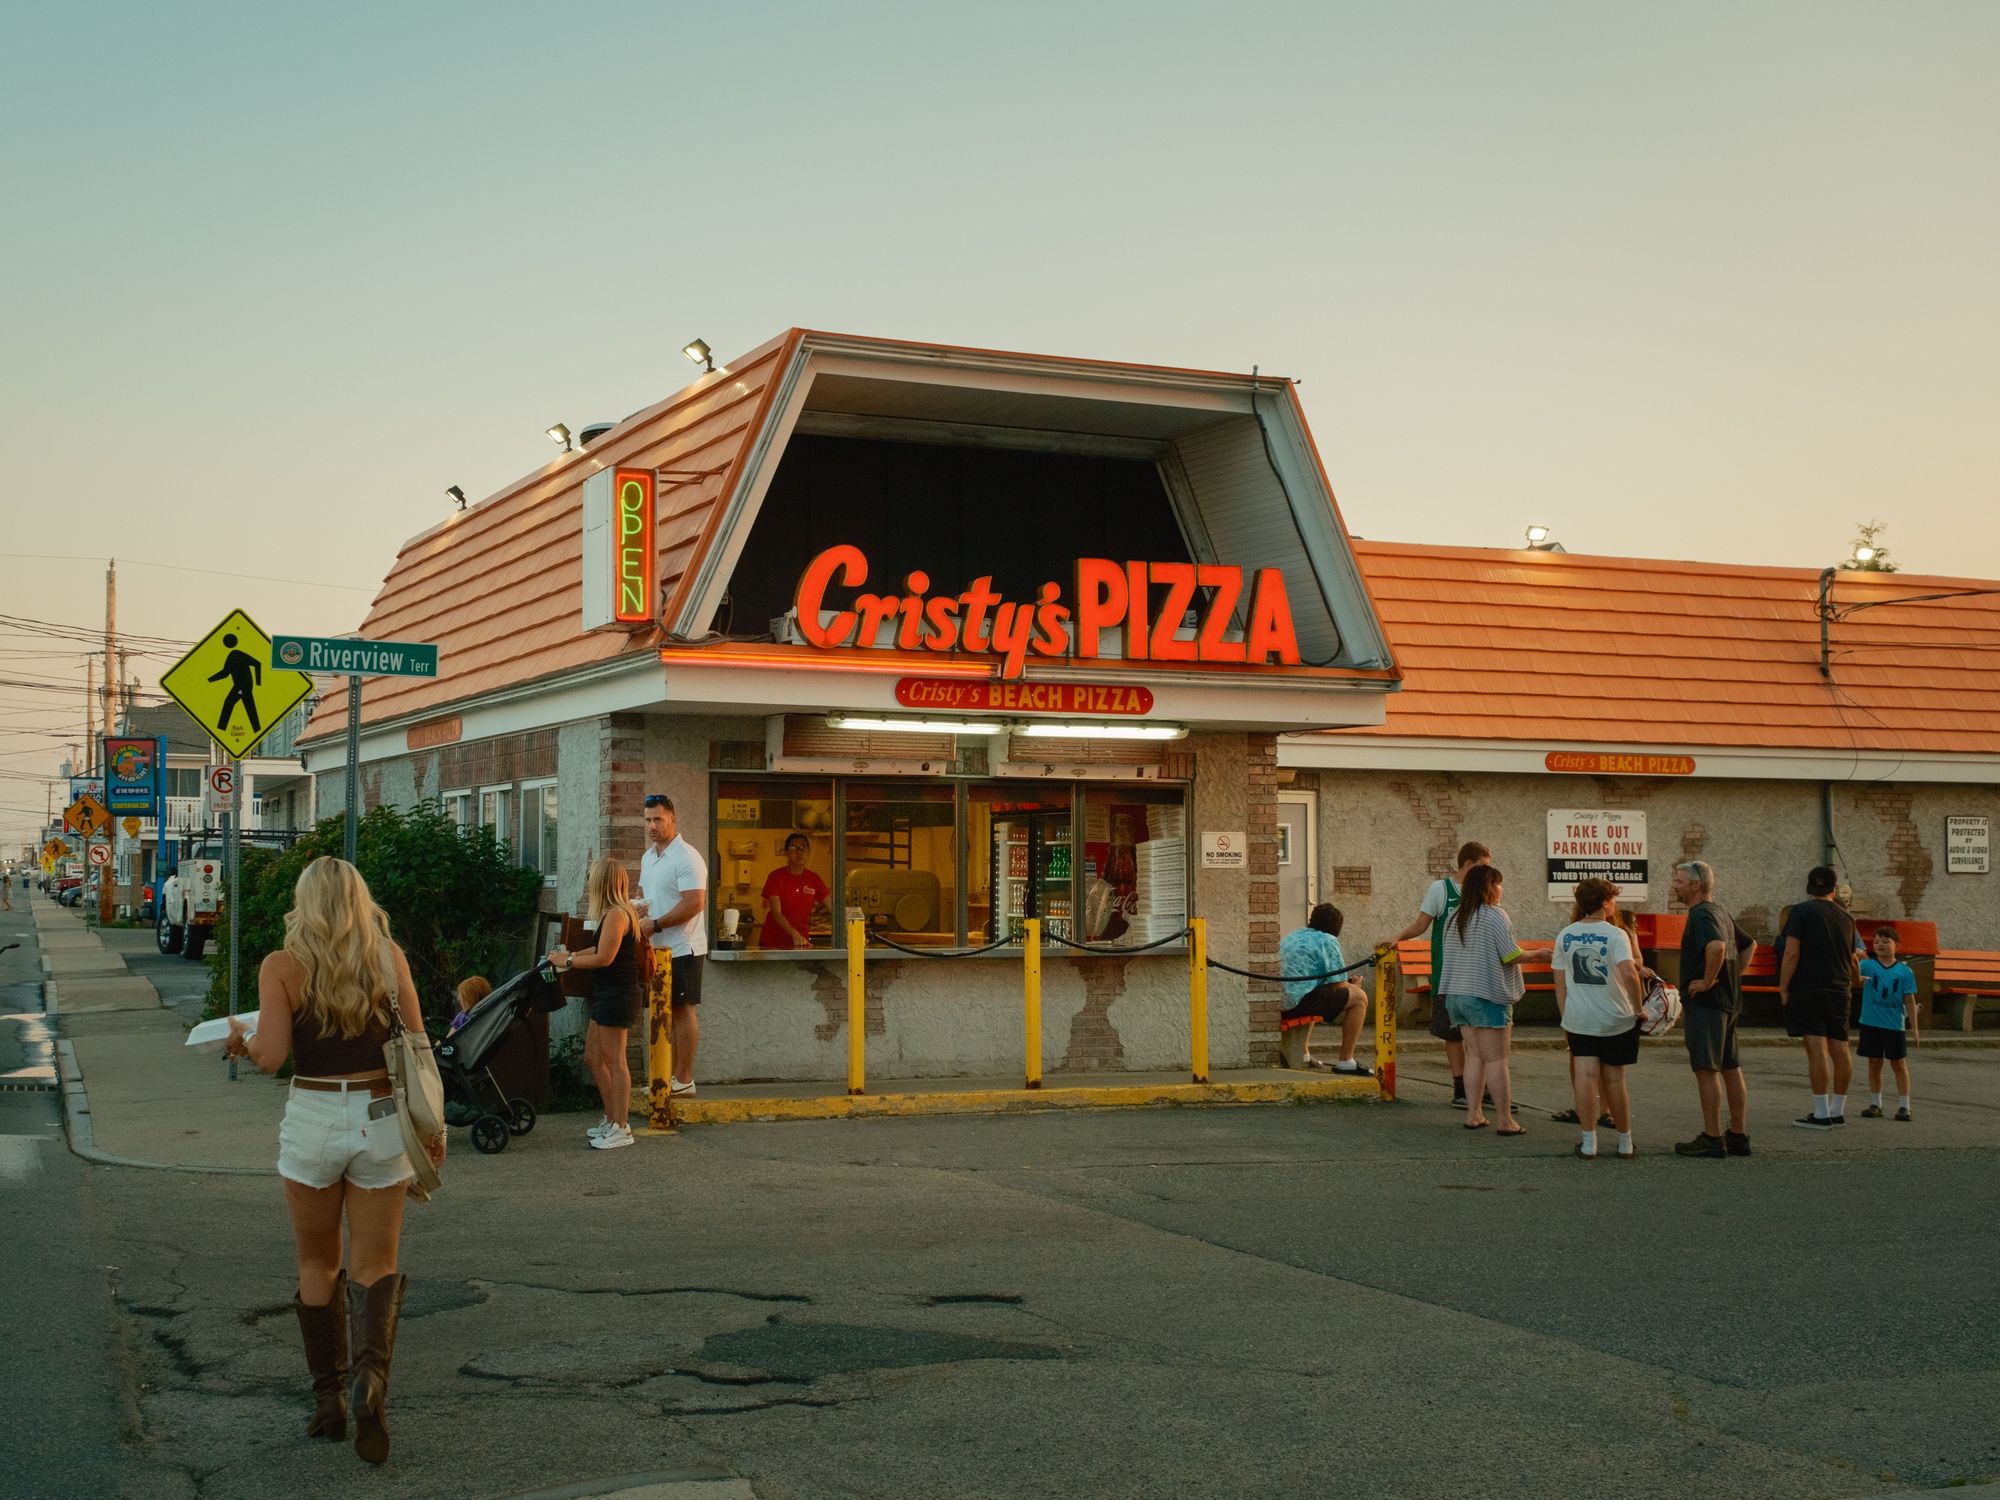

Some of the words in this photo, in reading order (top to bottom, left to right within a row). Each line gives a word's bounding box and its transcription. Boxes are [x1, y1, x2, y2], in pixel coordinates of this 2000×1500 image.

[621, 481, 644, 614] OPEN
[796, 544, 1070, 679] Cristy's
[1074, 558, 1300, 665] PIZZA
[309, 641, 404, 671] Riverview
[410, 658, 430, 673] Terr
[908, 681, 982, 706] Cristy's
[988, 684, 1063, 709] BEACH
[1073, 686, 1142, 712] PIZZA
[1553, 754, 1595, 769] Cristy's
[1599, 755, 1643, 772] BEACH
[1648, 757, 1689, 773] PIZZA
[1566, 825, 1598, 838] TAKE
[1607, 825, 1630, 838] OUT
[1951, 828, 1986, 836] PROTECTED
[1553, 842, 1610, 855] PARKING
[1613, 842, 1643, 855] ONLY
[1949, 846, 1966, 854] AUDIO
[1972, 846, 1988, 854] VIDEO
[1564, 861, 1611, 870] UNATTENDED
[1612, 861, 1632, 870] CARS
[1552, 872, 1578, 880] TOWED
[1579, 872, 1588, 880] TO
[1614, 872, 1643, 881] GARAGE
